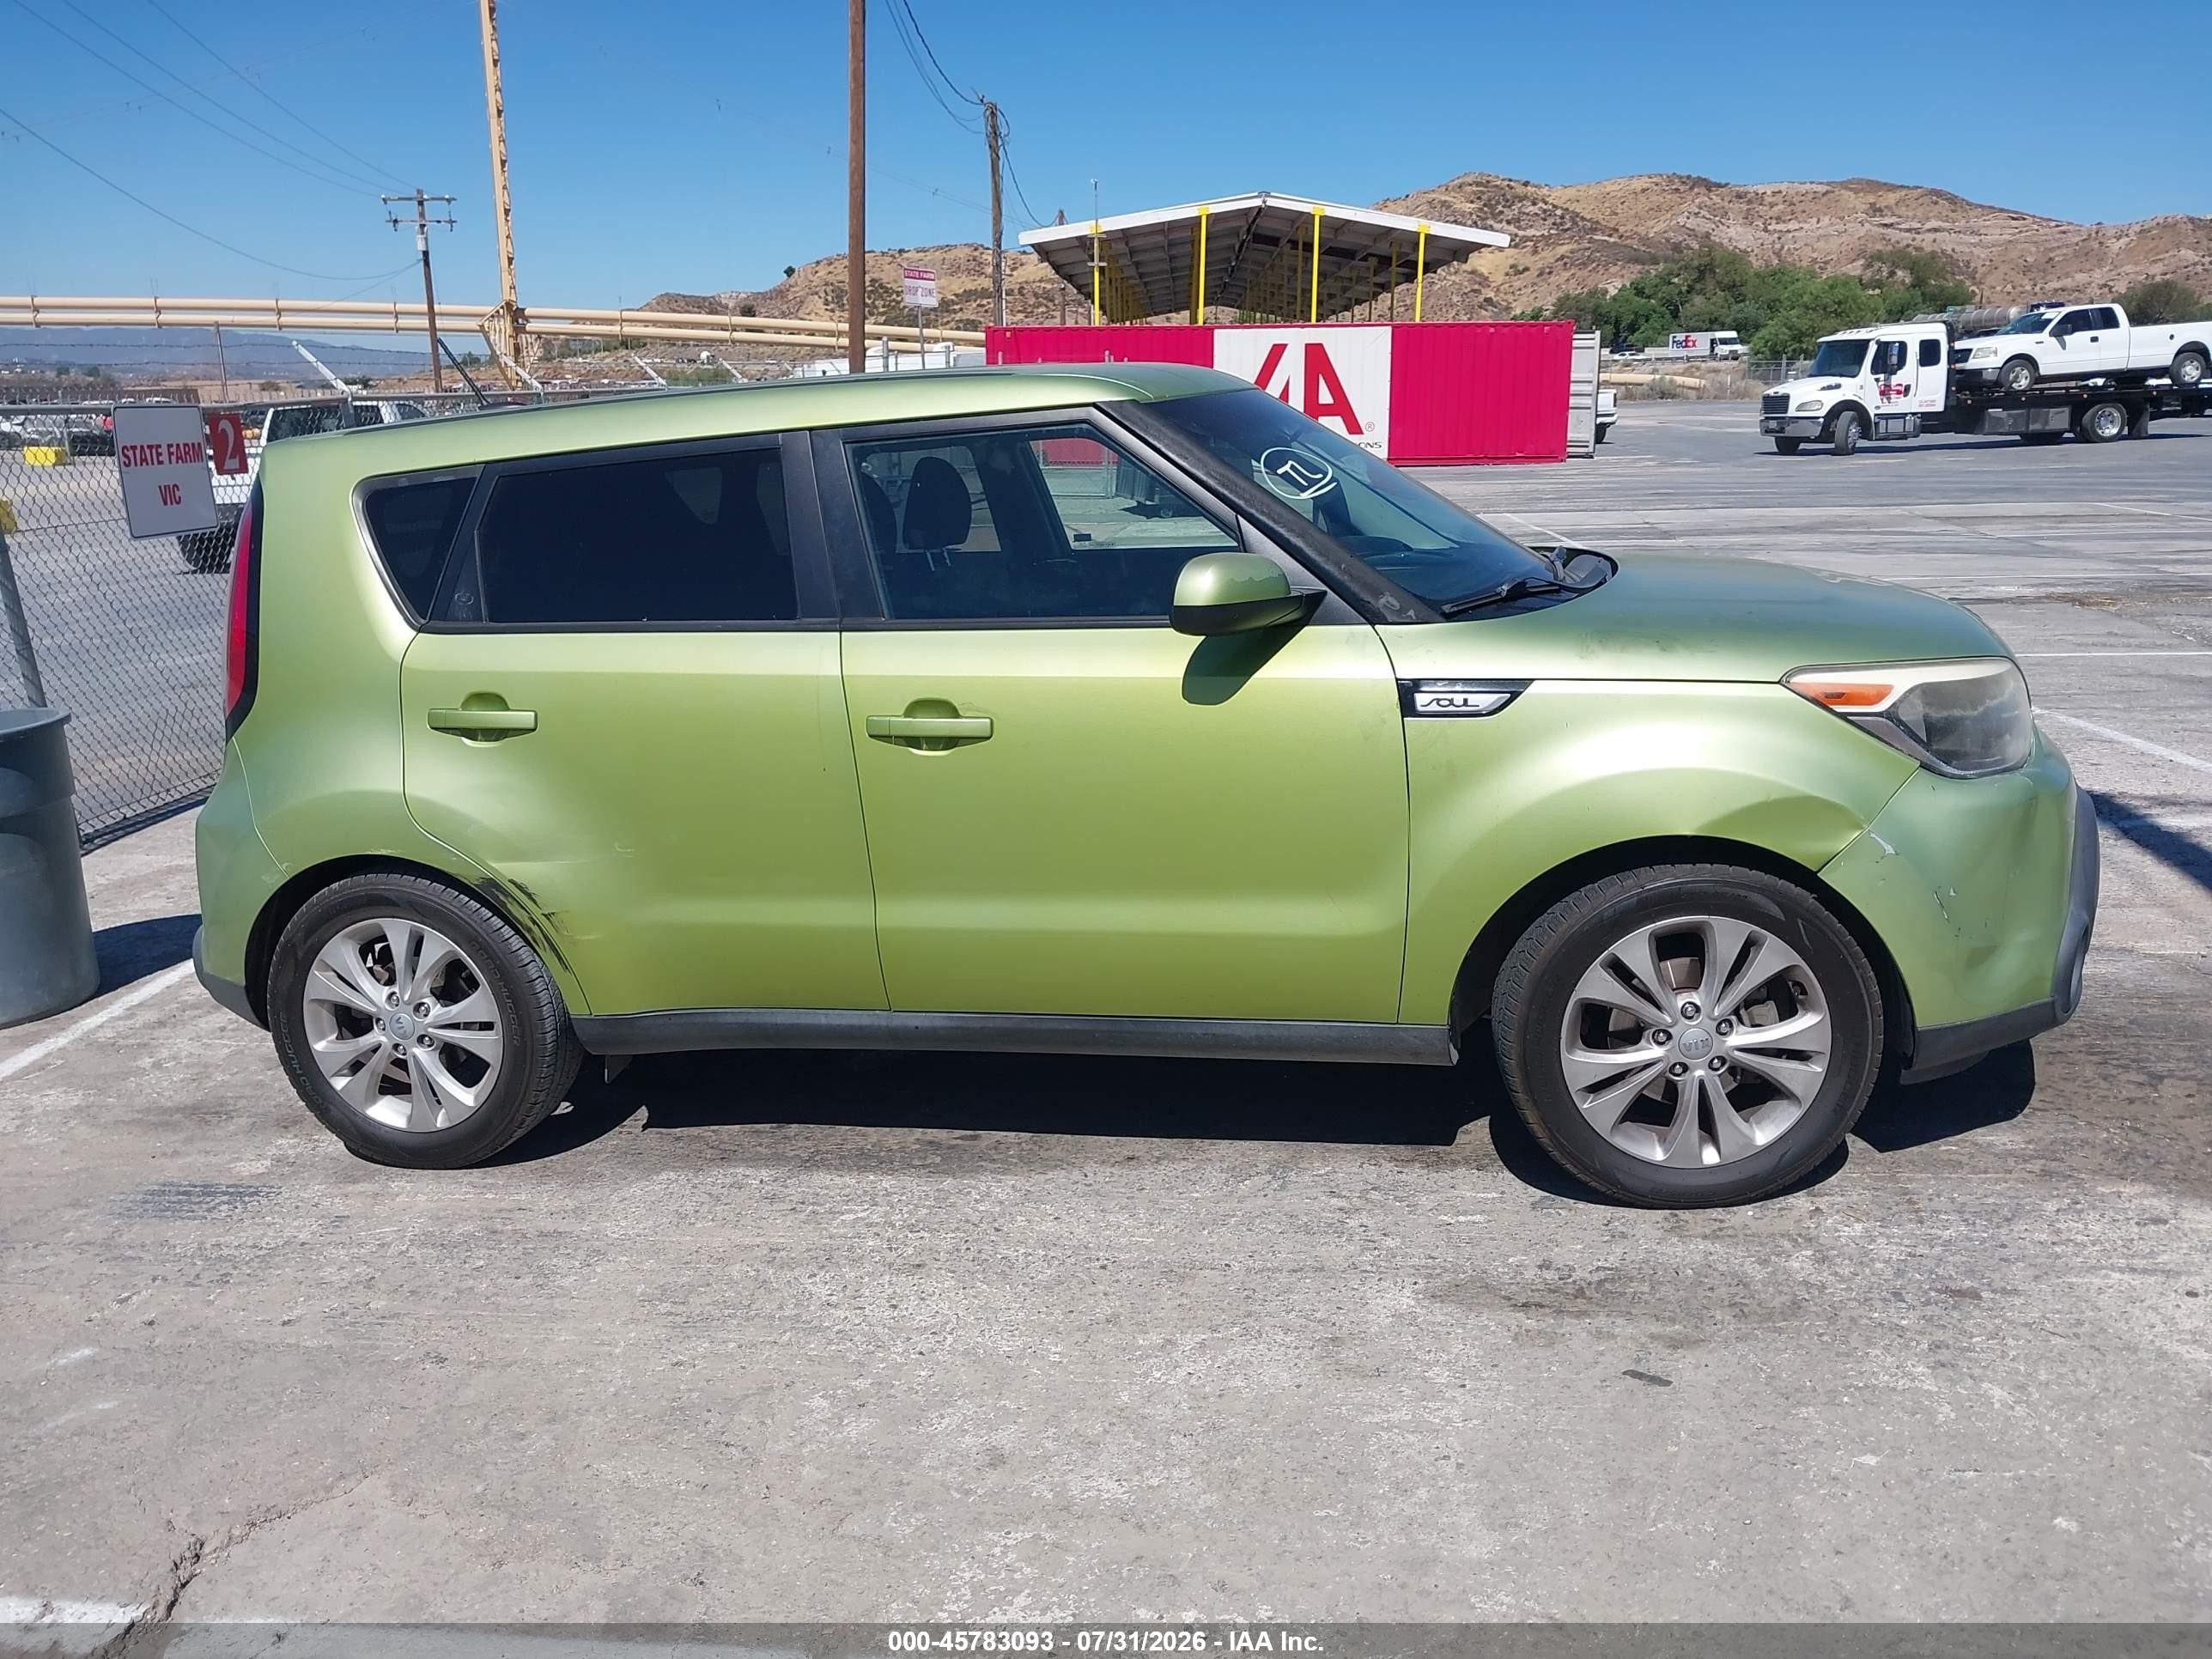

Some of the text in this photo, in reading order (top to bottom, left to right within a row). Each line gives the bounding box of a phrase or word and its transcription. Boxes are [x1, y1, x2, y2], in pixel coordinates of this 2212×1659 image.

[1671, 335, 1698, 349] FedEx
[121, 441, 204, 468] STATE FARM
[216, 418, 240, 471] 2
[158, 483, 182, 507] VIC
